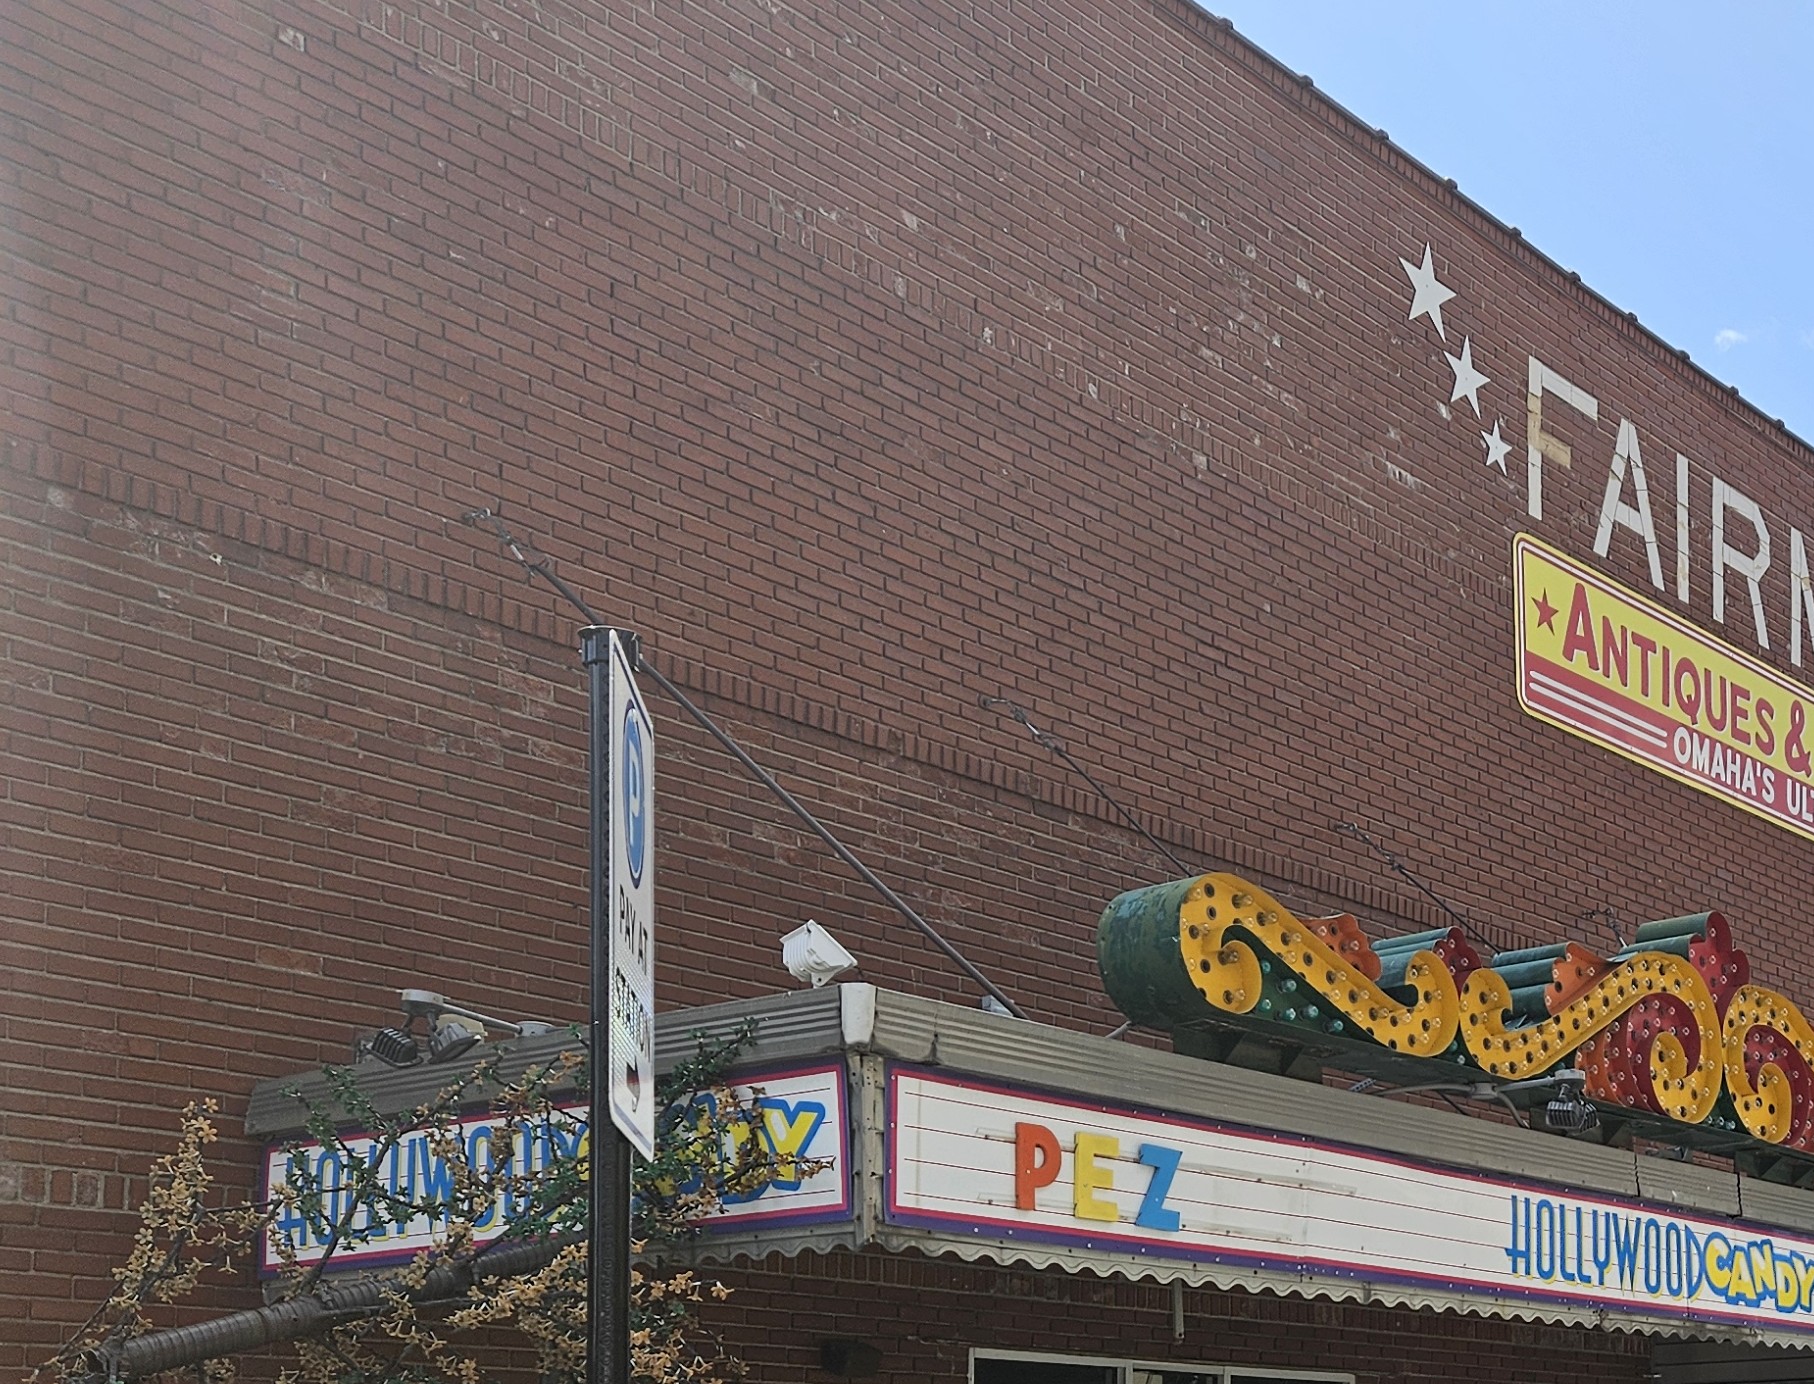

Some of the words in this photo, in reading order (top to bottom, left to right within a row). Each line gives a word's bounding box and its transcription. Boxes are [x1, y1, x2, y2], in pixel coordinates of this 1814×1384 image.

[1562, 583, 1775, 758] ANTIQUES
[1784, 700, 1813, 777] &
[1673, 726, 1776, 806] OMAHA'S
[619, 883, 636, 955] PAY
[638, 920, 648, 976] AT
[1015, 1121, 1183, 1233] PEZ
[1505, 1194, 1707, 1302] HOLLYWOOD
